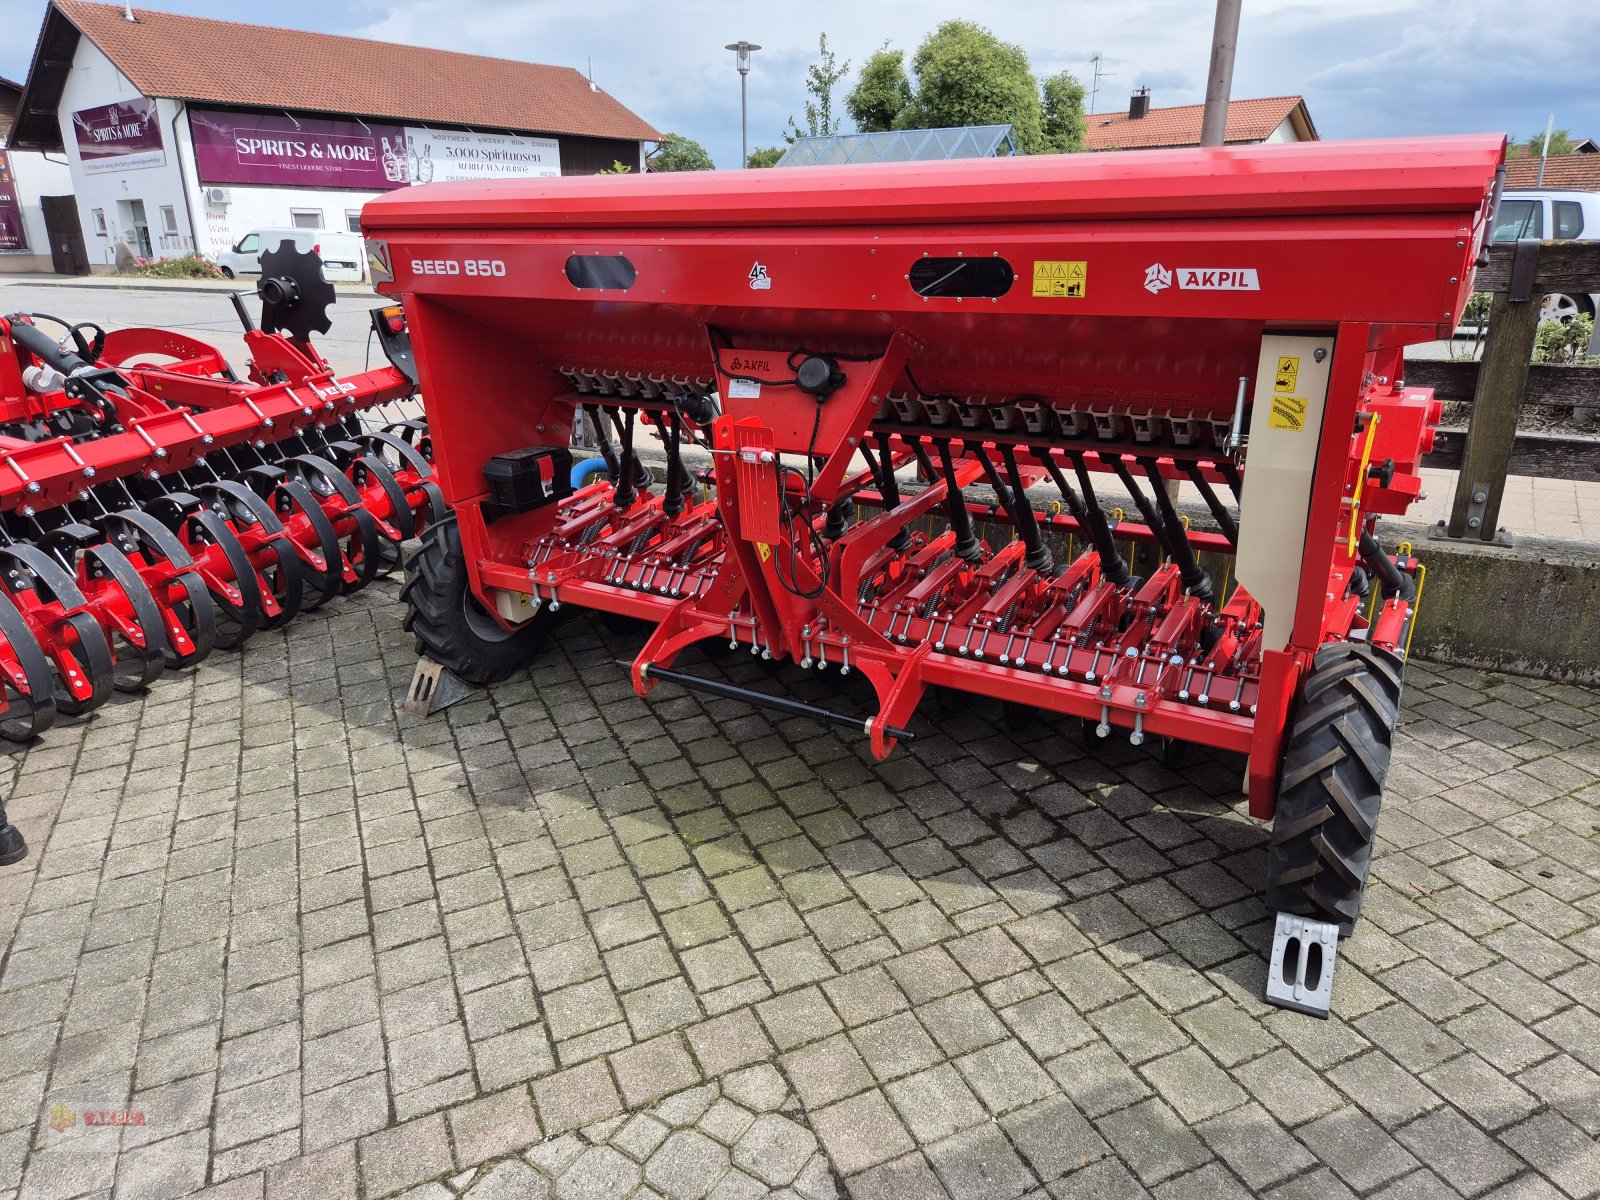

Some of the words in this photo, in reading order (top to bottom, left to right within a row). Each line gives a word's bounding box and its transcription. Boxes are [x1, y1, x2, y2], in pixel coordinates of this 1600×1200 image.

[93, 126, 116, 142] SPIRITS
[116, 125, 123, 140] &
[122, 122, 143, 139] MORE
[236, 138, 307, 158] SPIRITS
[310, 142, 323, 159] &
[327, 143, 375, 162] MORE
[445, 146, 479, 159] 3.000
[480, 148, 541, 163] Spirituosen
[278, 163, 299, 171] FINEST
[324, 165, 344, 173] STORE
[411, 259, 460, 275] SEED
[463, 259, 506, 277] 850
[750, 262, 767, 279] 45
[1185, 270, 1250, 288] AKPIL
[743, 359, 770, 371] AKPIL
